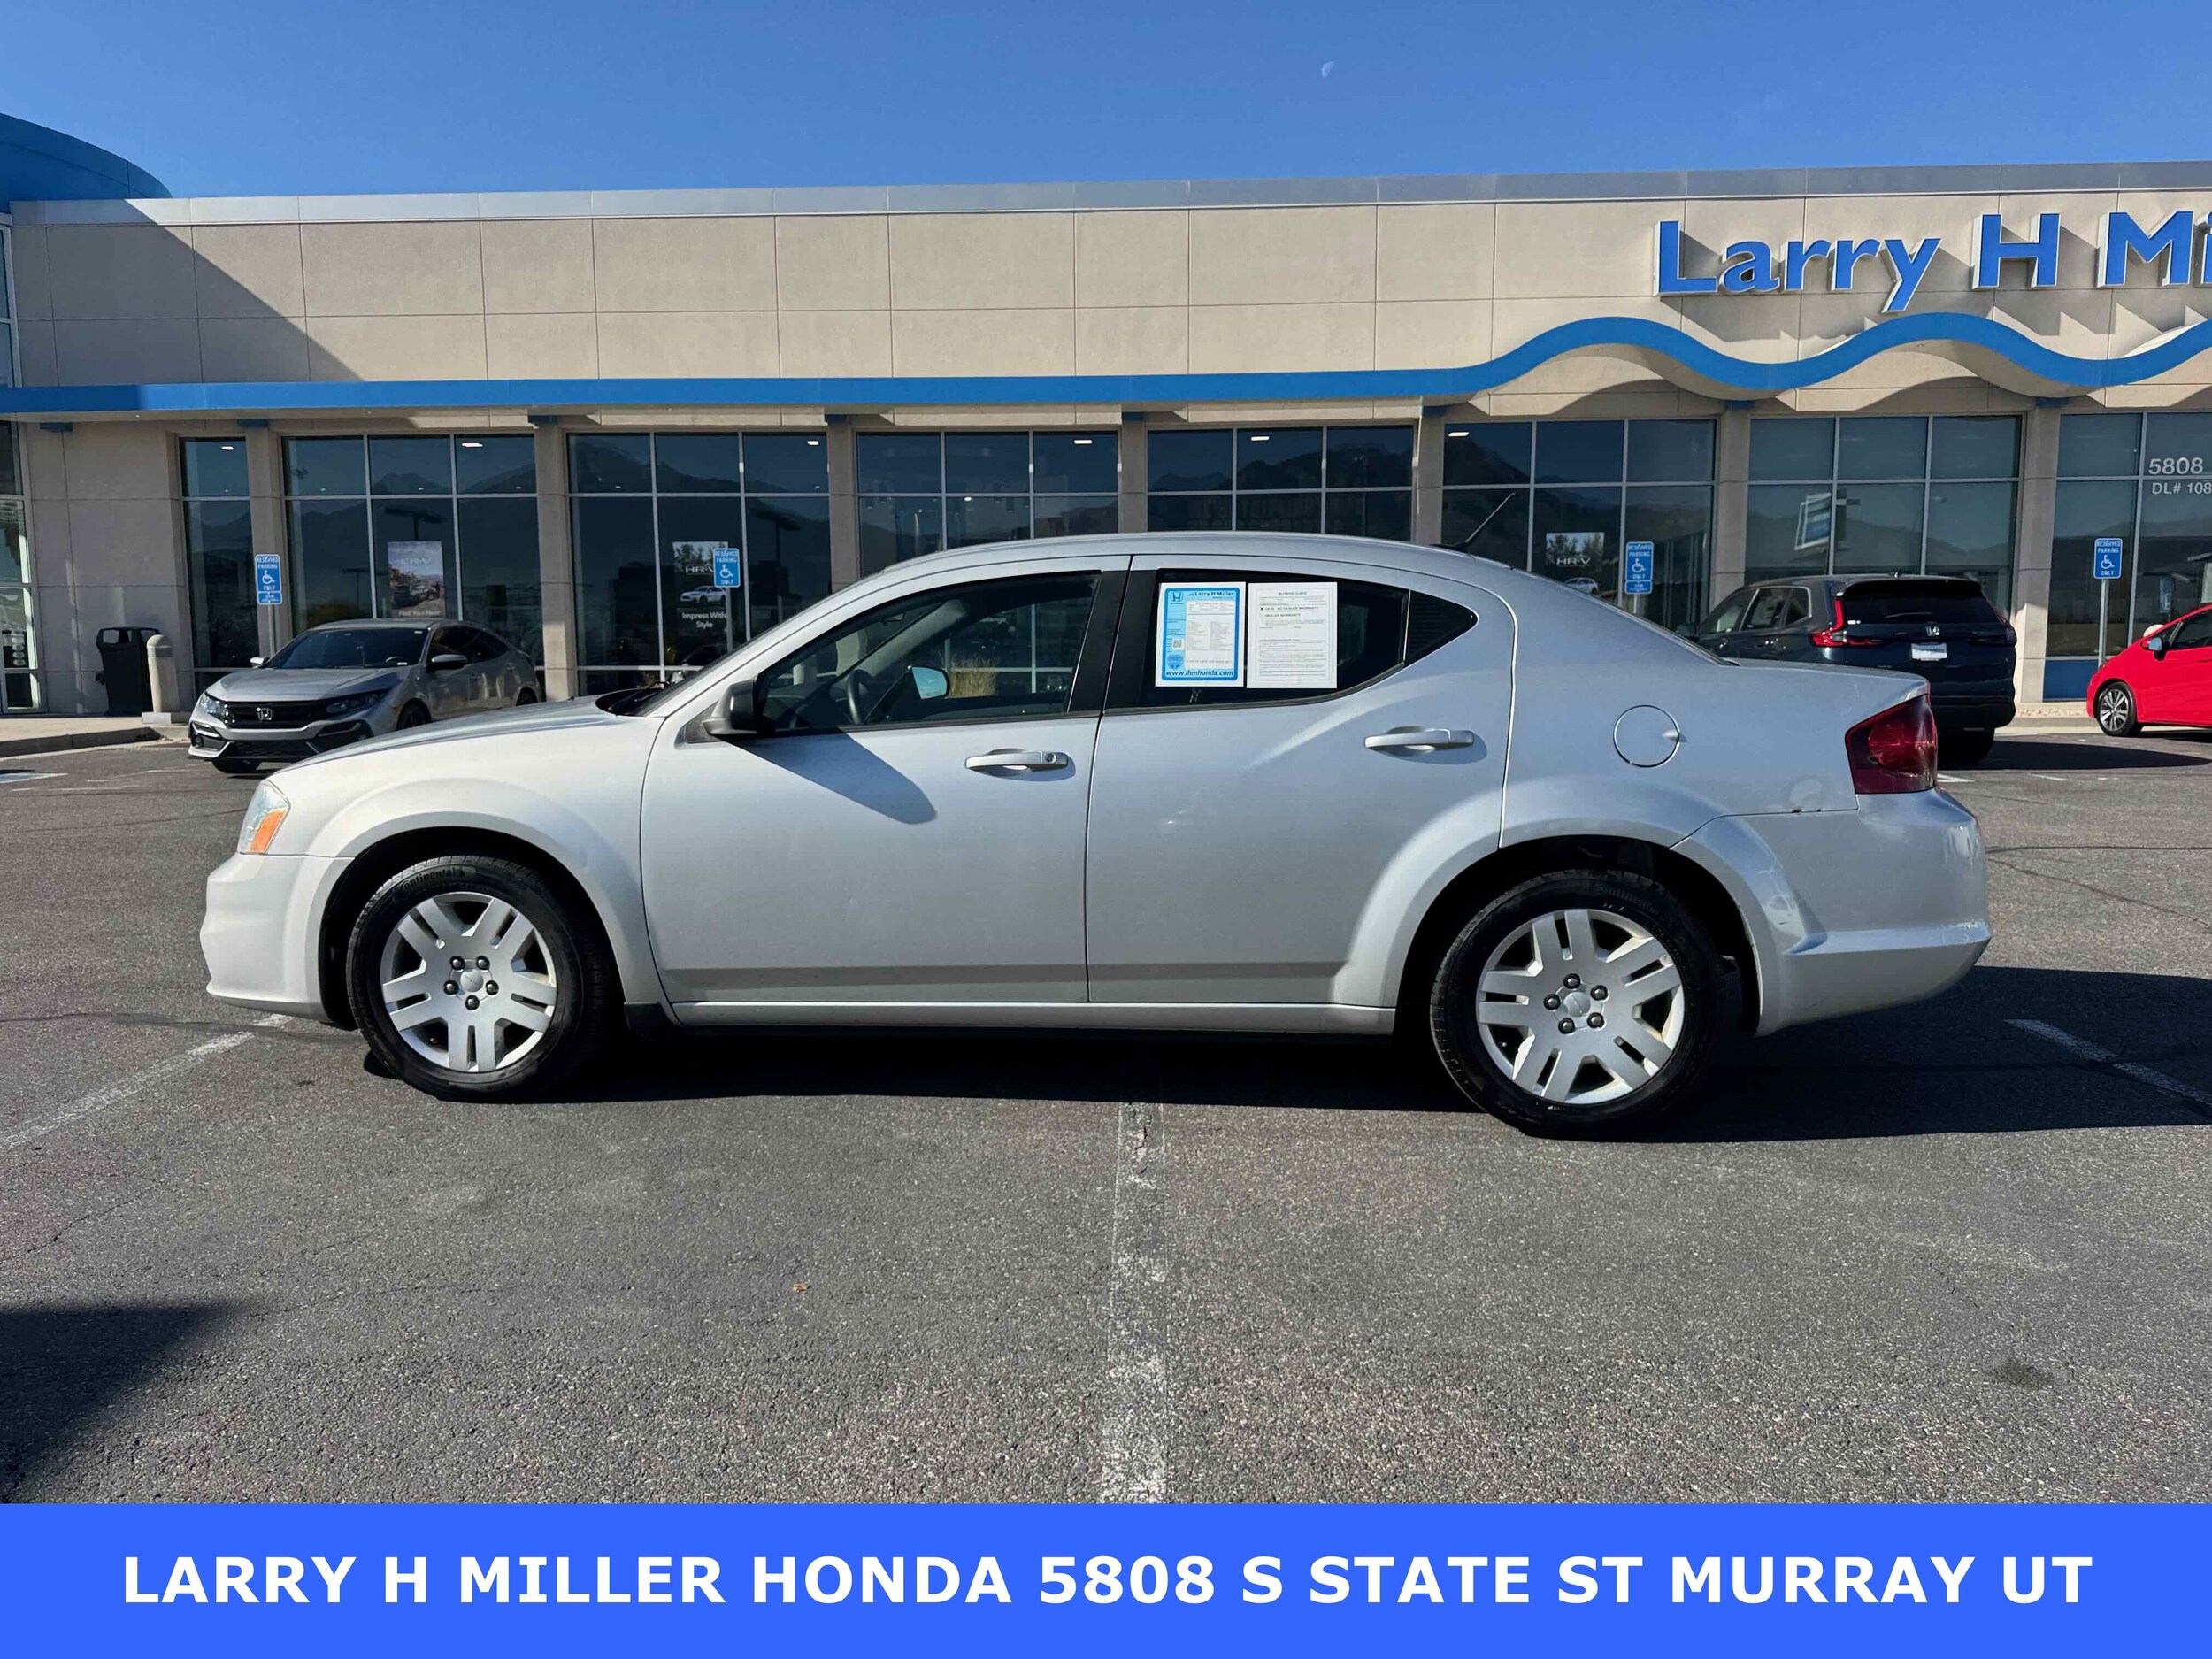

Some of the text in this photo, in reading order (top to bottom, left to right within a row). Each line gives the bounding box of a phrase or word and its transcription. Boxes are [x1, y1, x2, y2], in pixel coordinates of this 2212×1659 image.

[1655, 220, 1941, 313] Larry
[1972, 213, 2061, 289] H
[2148, 457, 2204, 475] 5808
[2152, 482, 2181, 495] DL#
